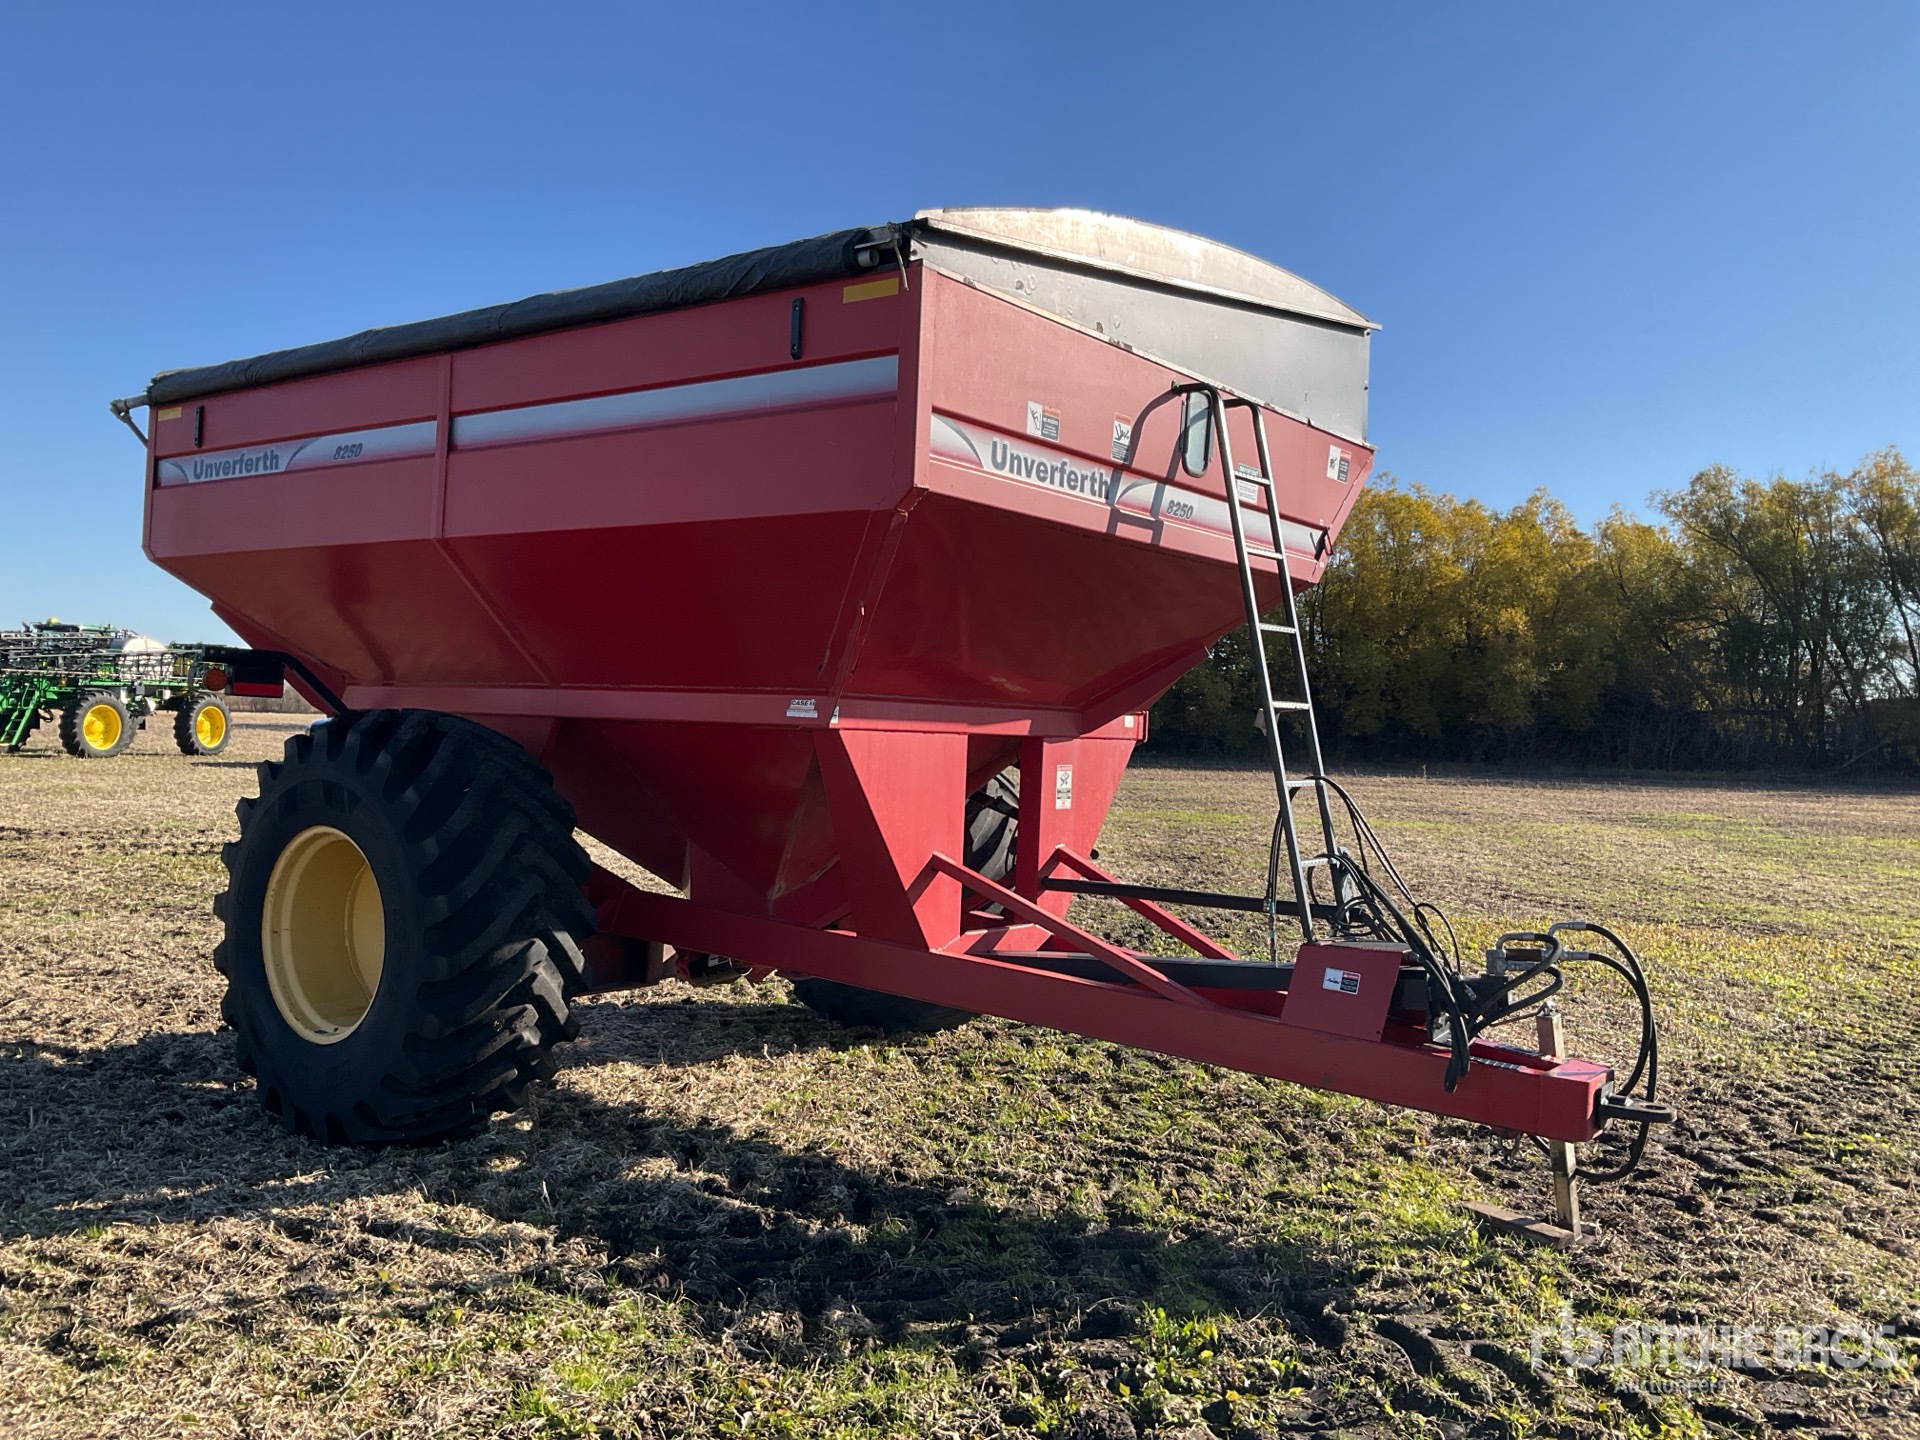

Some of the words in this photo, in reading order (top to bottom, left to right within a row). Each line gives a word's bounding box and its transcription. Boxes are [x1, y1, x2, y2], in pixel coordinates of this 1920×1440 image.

[333, 443, 363, 461] 8250
[193, 450, 280, 480] Unverferth
[991, 440, 1110, 500] Unverferth
[1166, 499, 1194, 520] 8250
